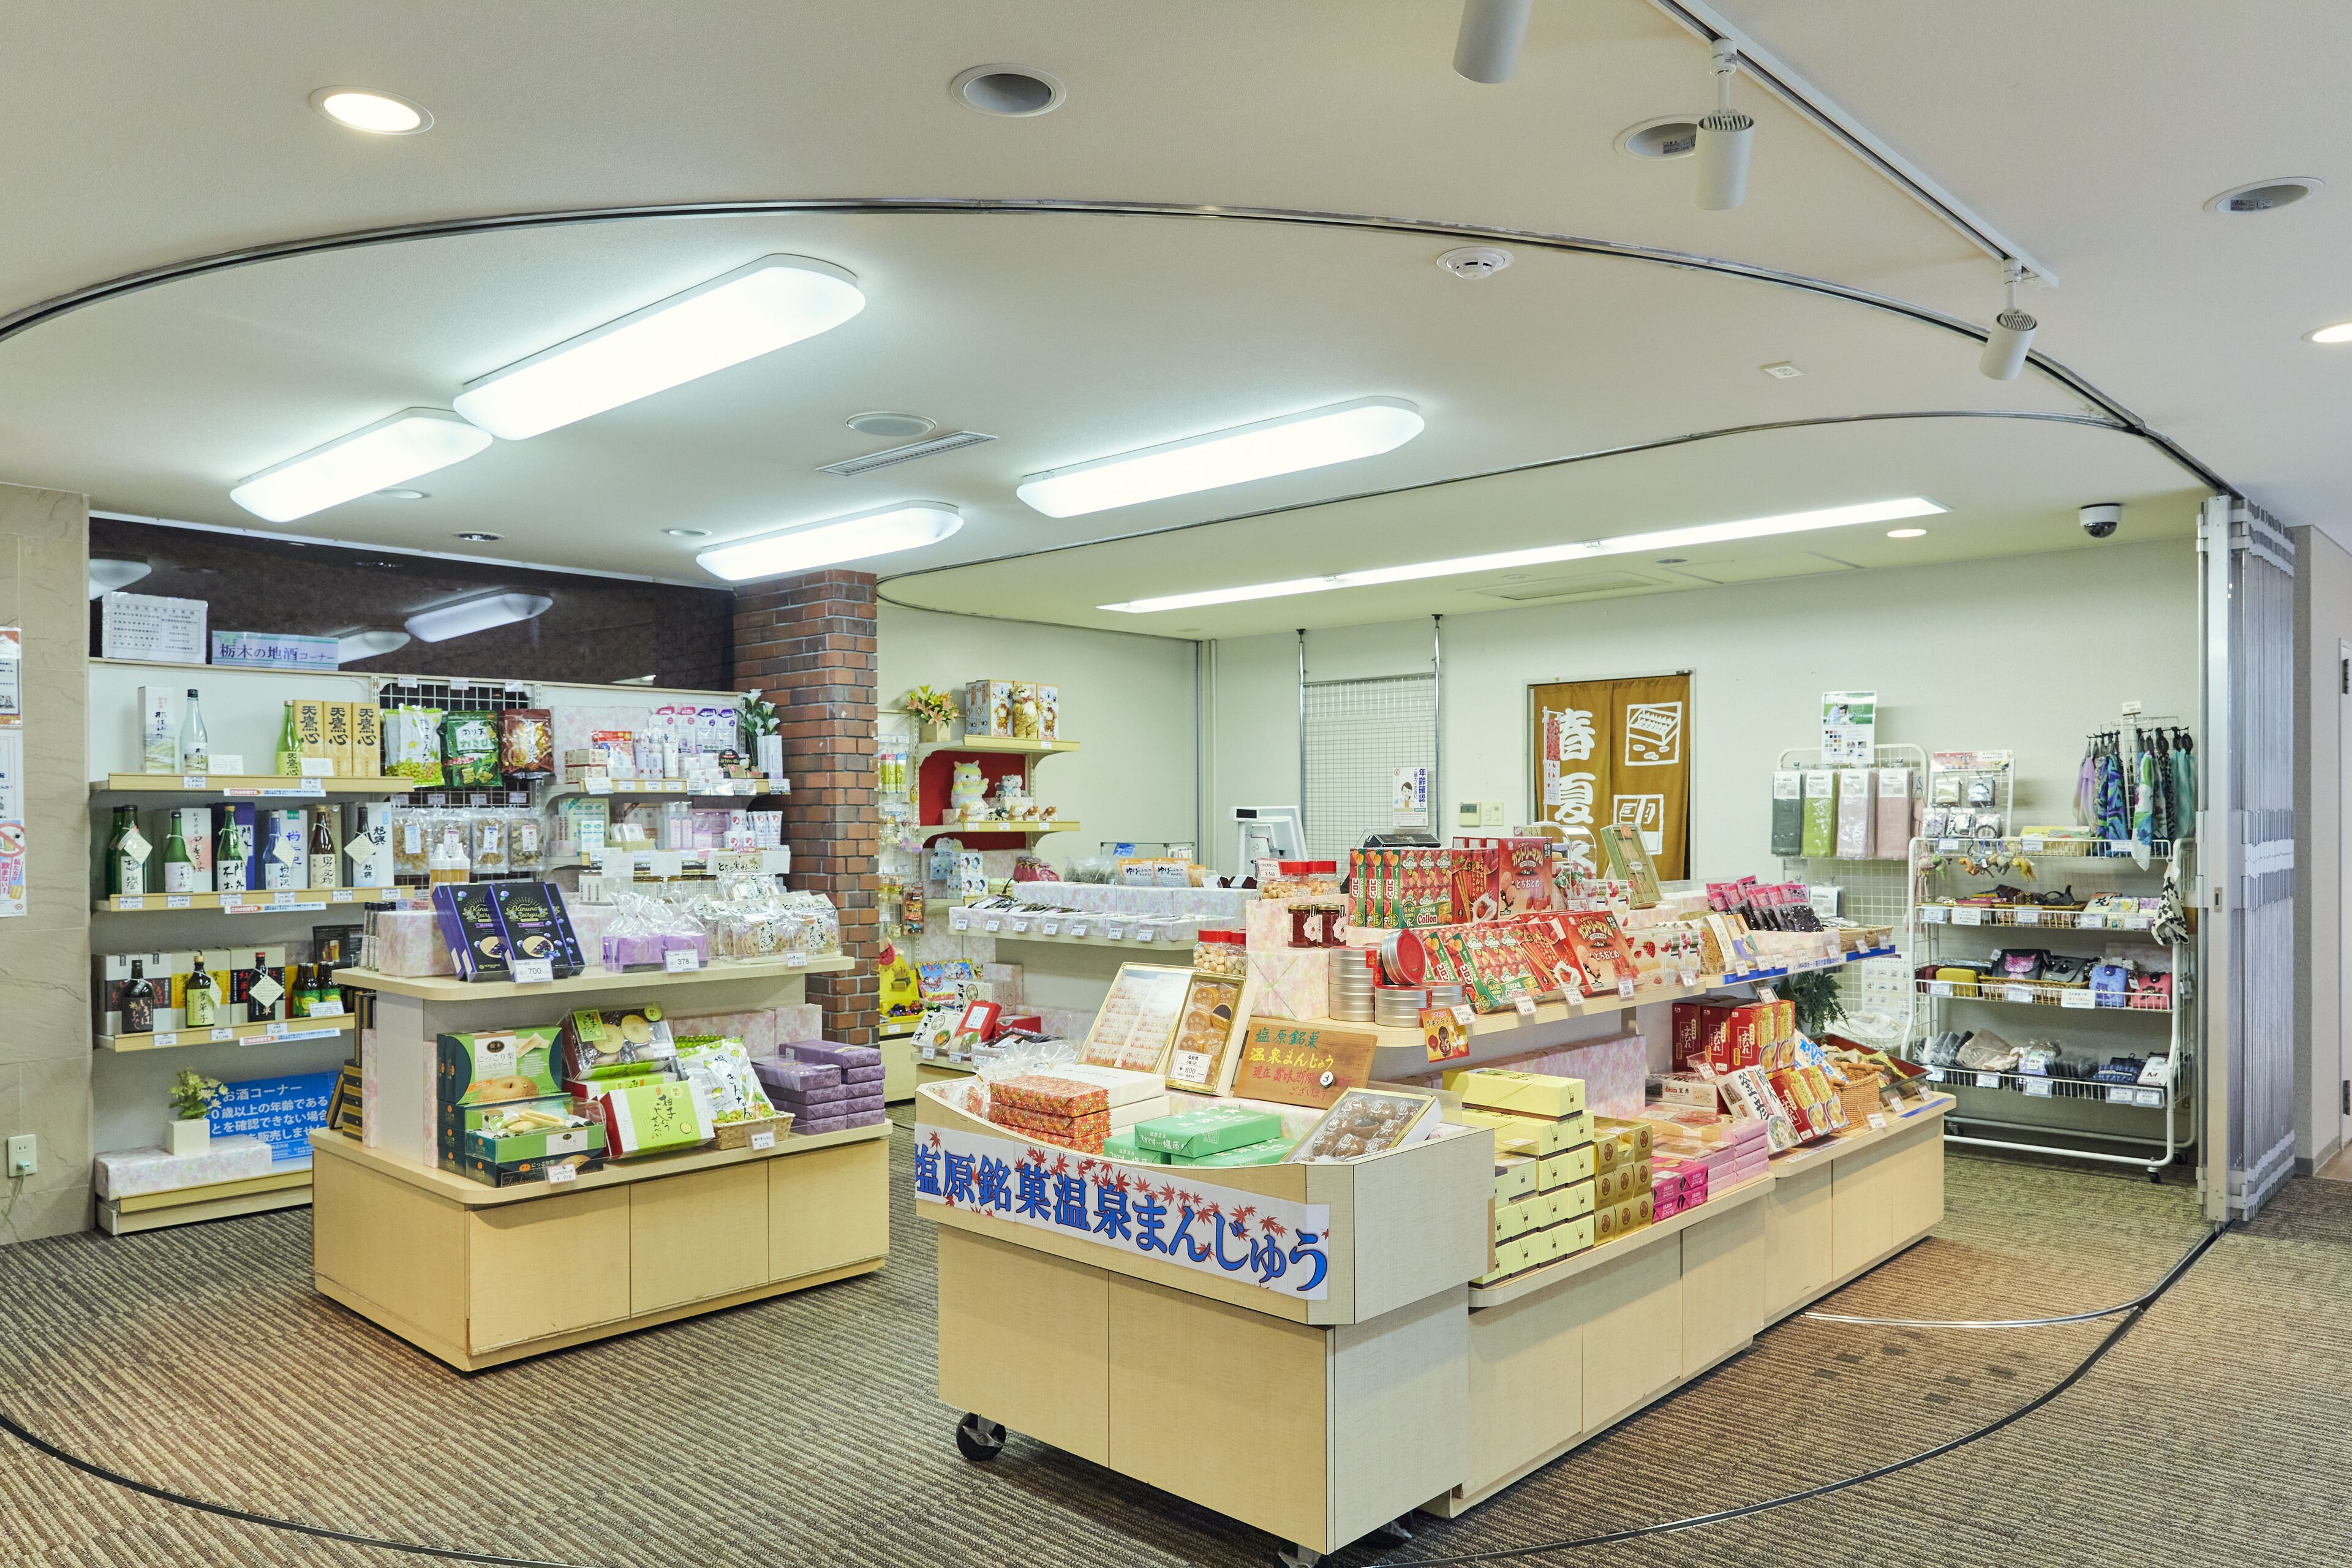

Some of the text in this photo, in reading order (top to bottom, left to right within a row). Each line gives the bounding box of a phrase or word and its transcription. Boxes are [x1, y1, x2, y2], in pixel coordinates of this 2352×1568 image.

[219, 643, 335, 662] 栃木の地酒コーナー
[1511, 846, 1544, 867] カントリーマアム
[1369, 878, 1378, 899] コロン
[1515, 878, 1540, 889] とちおとめ
[513, 903, 538, 913] Kinuno
[1417, 914, 1438, 925] Collon
[1577, 920, 1615, 941] カントリーマアム
[1594, 949, 1620, 960] とちおとめ
[1460, 963, 1474, 985] コロン
[1426, 1017, 1453, 1028] 生キャラメル
[1256, 1027, 1321, 1049] 塩原銘菓
[1713, 1028, 1721, 1052] ふかひれ
[1741, 1030, 1751, 1055] ふかひれ
[477, 1052, 515, 1063] にっこり梨
[477, 1061, 513, 1071] しっとりケーキ
[1248, 1047, 1334, 1071] 温泉まんじゅう
[223, 1084, 303, 1102] お酒コーナー
[1289, 1086, 1329, 1101] ございます
[915, 1142, 1329, 1292] 塩原銘菓温泉まんじゅう
